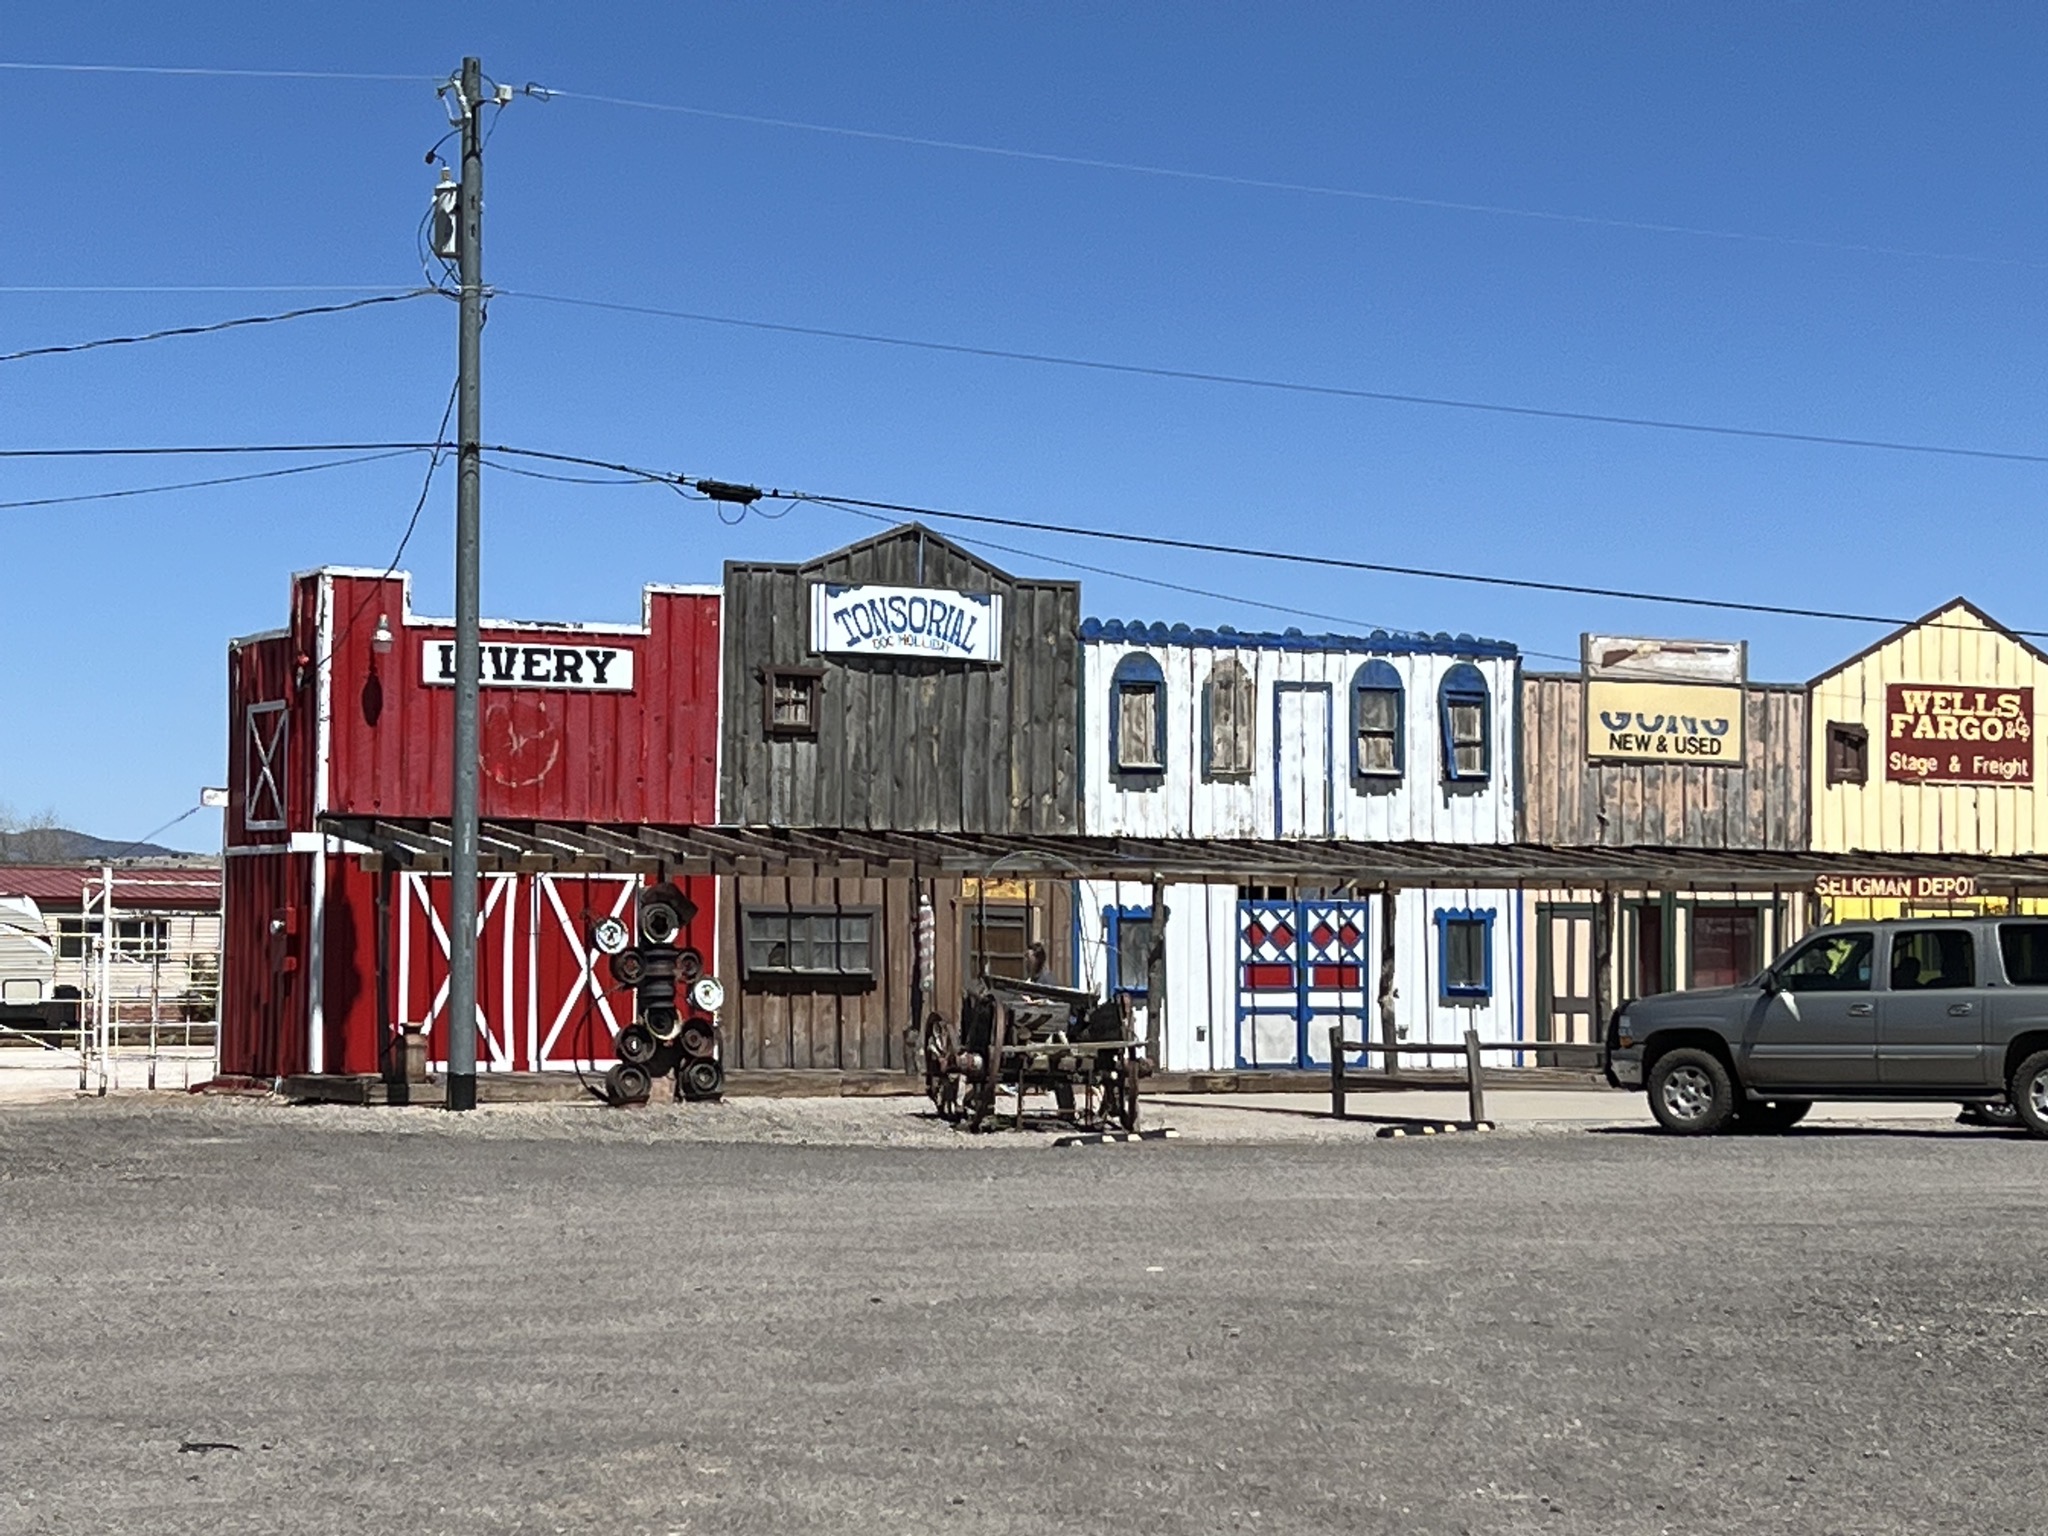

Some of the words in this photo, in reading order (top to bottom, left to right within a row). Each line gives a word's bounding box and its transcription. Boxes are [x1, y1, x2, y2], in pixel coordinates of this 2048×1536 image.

[833, 595, 978, 654] TONSORIAL
[872, 635, 895, 650] DOC
[1901, 690, 2021, 718] WELLS
[1890, 713, 2004, 742] FARGO
[1609, 733, 1653, 752] NEW
[1656, 734, 1668, 753] &
[1674, 736, 1722, 755] USED
[1889, 751, 1938, 776] Stage
[1948, 754, 1961, 773] &
[1972, 755, 2029, 779] Freight
[1814, 875, 1911, 896] SELIGMAN
[1918, 876, 1976, 896] DEPOT
